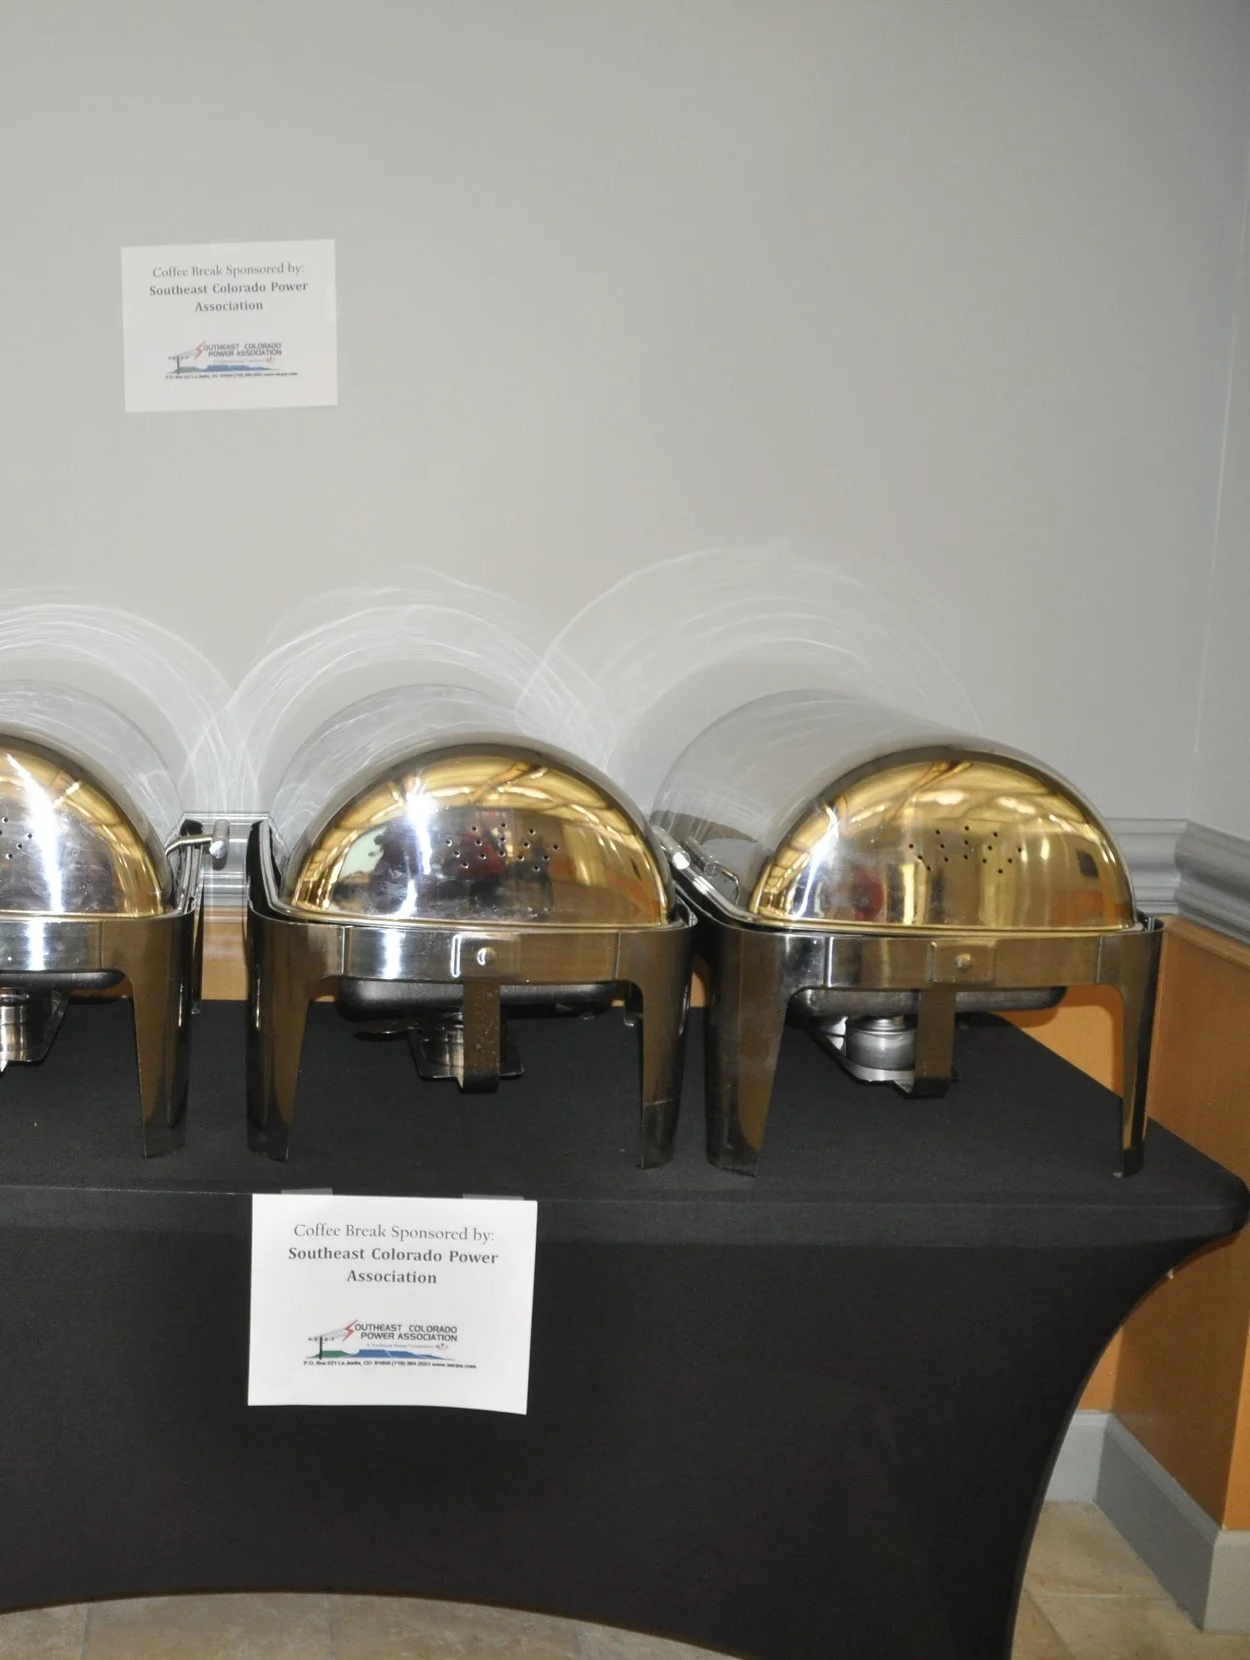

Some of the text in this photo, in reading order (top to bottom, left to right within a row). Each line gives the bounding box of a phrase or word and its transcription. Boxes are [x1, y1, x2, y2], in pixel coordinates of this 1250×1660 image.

[152, 262, 304, 278] Coffee Break Sponsored by:
[149, 281, 309, 297] Southeast Colorado Power
[194, 300, 264, 313] Association
[236, 349, 282, 357] ASSOCIATION
[293, 1222, 495, 1245] Coffee Break Sponsored by:
[288, 1247, 499, 1264] Southeast Colorado Power
[346, 1269, 437, 1284] Association
[408, 1324, 458, 1334] COLORADO
[360, 1332, 458, 1342] POWER ASSOCIATION
